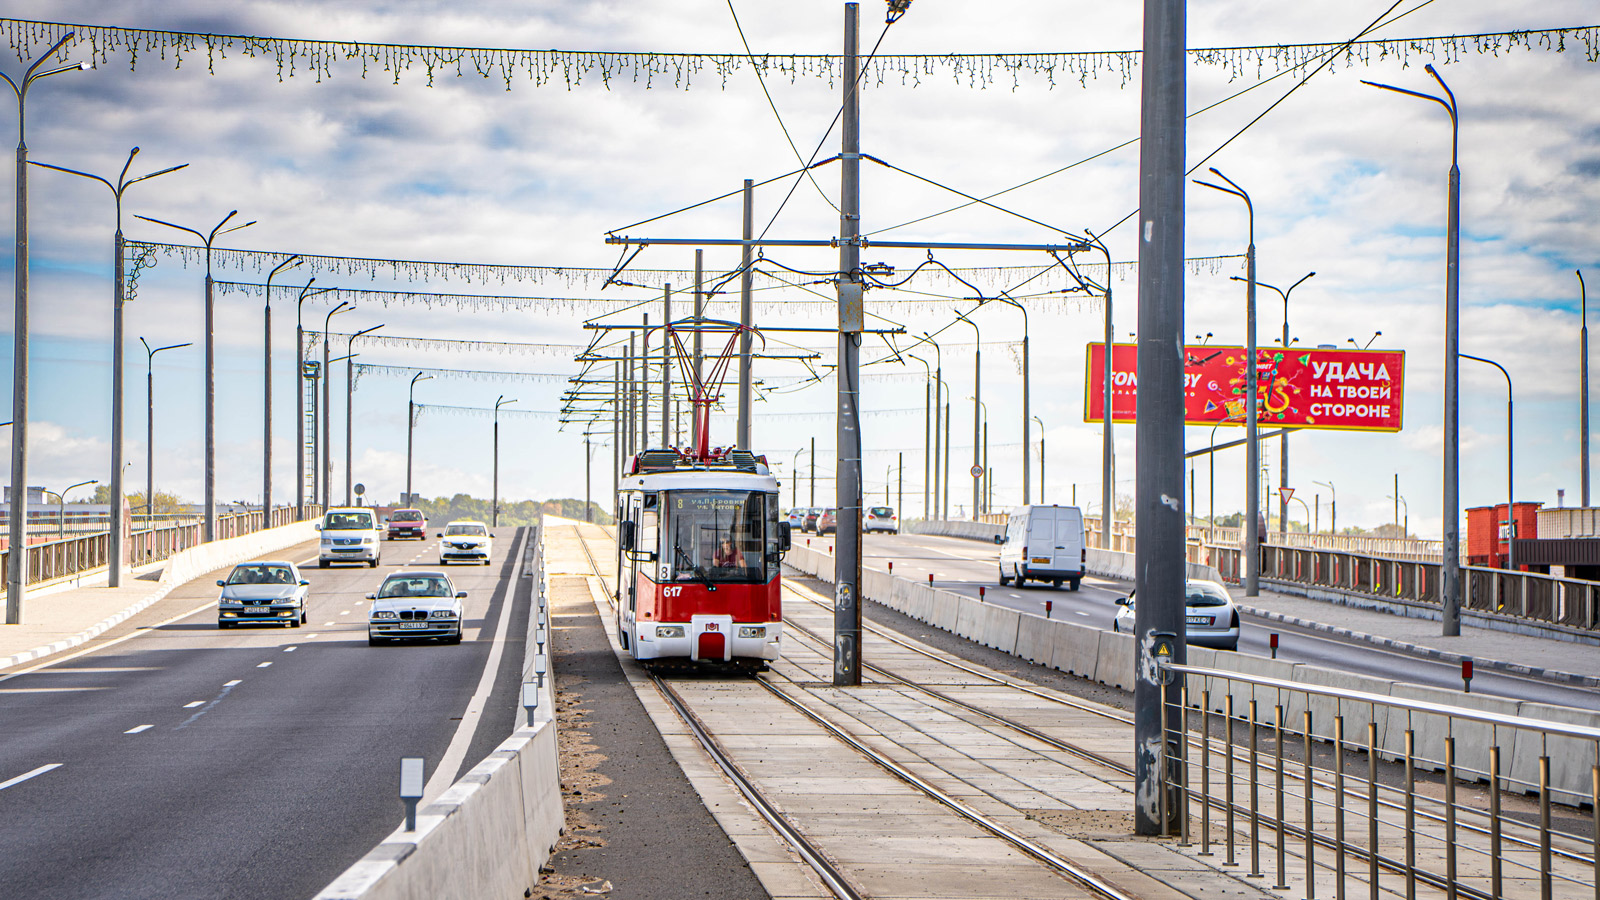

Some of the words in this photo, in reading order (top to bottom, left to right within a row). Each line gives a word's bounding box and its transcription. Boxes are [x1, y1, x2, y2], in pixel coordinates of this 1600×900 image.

[1311, 361, 1391, 383] УДАЧА
[1310, 385, 1333, 398] НА
[1337, 382, 1391, 399] ТВОЕЙ
[1310, 403, 1391, 418] СТОРОНЕ
[677, 499, 683, 509] 8
[661, 566, 668, 579] 8
[663, 586, 683, 598] 617
